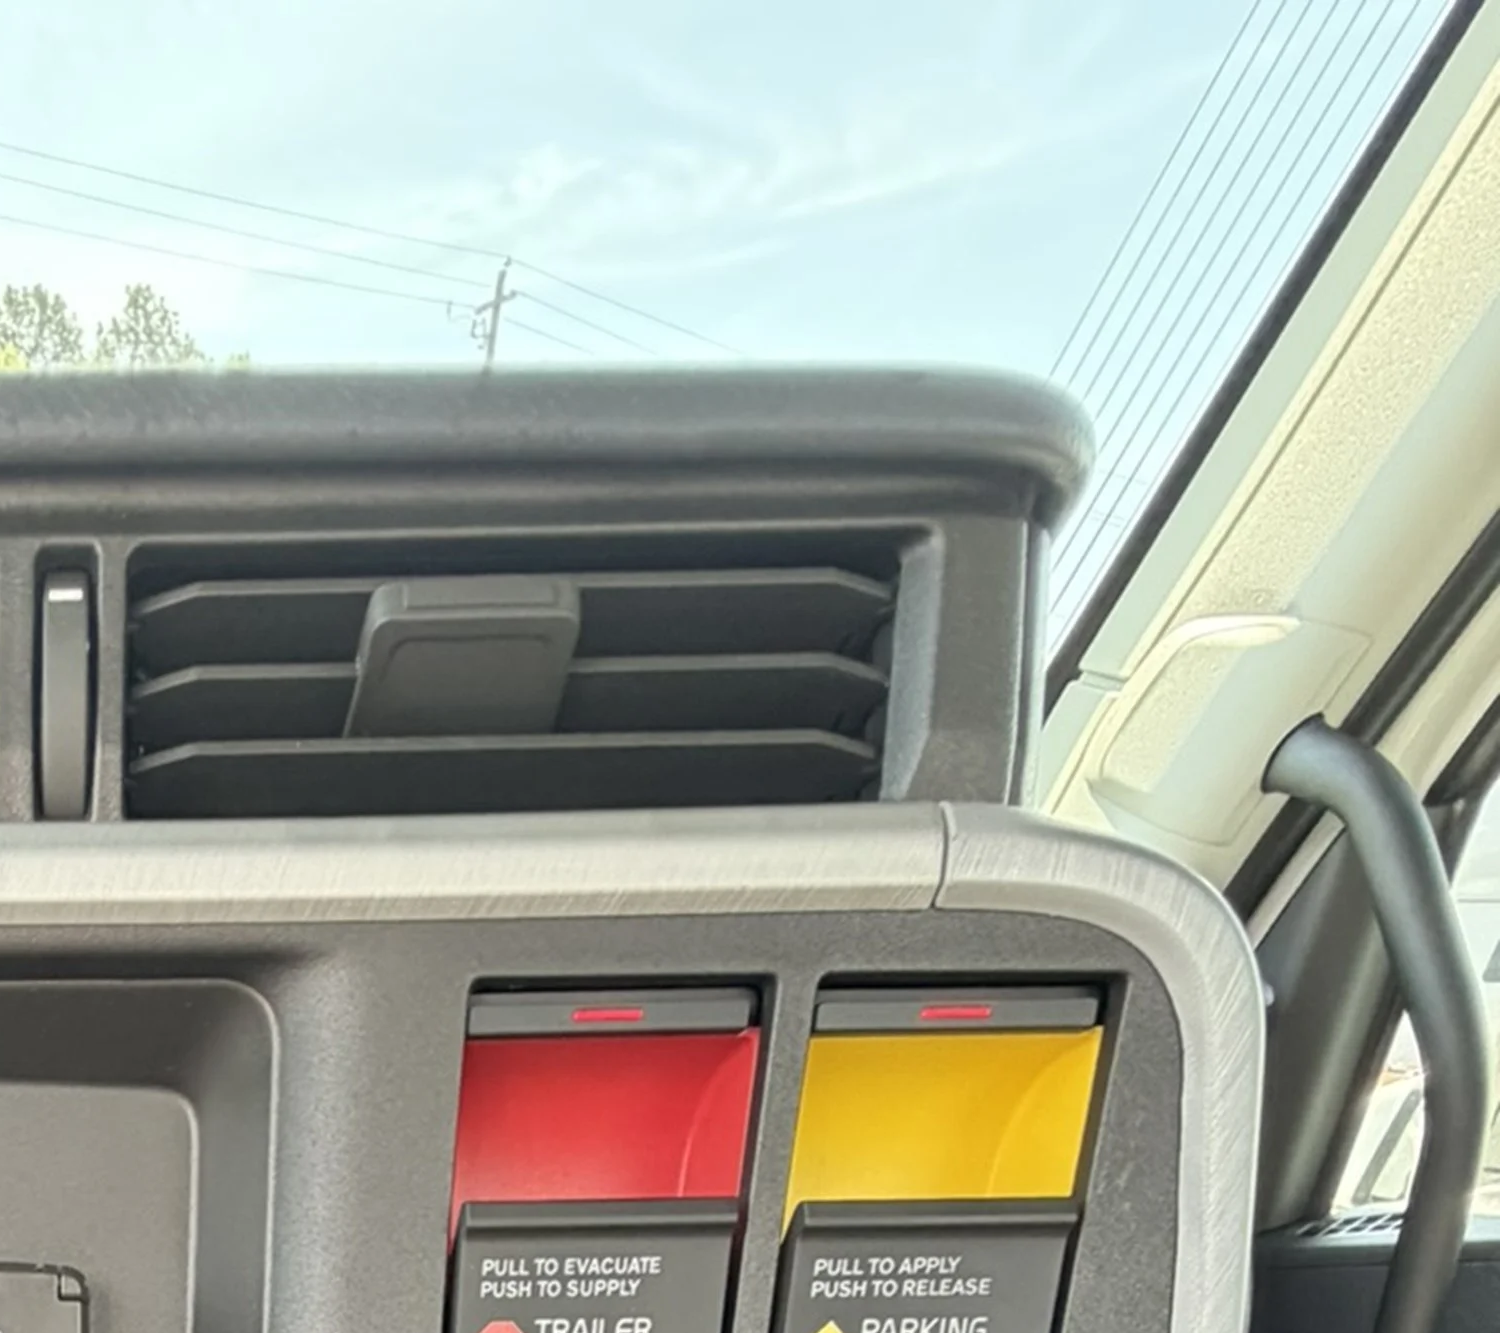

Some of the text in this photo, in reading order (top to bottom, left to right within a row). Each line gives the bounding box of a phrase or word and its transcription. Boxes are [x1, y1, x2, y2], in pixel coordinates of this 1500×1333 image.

[481, 1255, 662, 1277] PULL TO EVACUATE
[813, 1255, 962, 1277] PULL TO APPLY
[479, 1278, 641, 1299] PUSH TO SUPPLY
[809, 1278, 992, 1299] PUSH TO RELEASE
